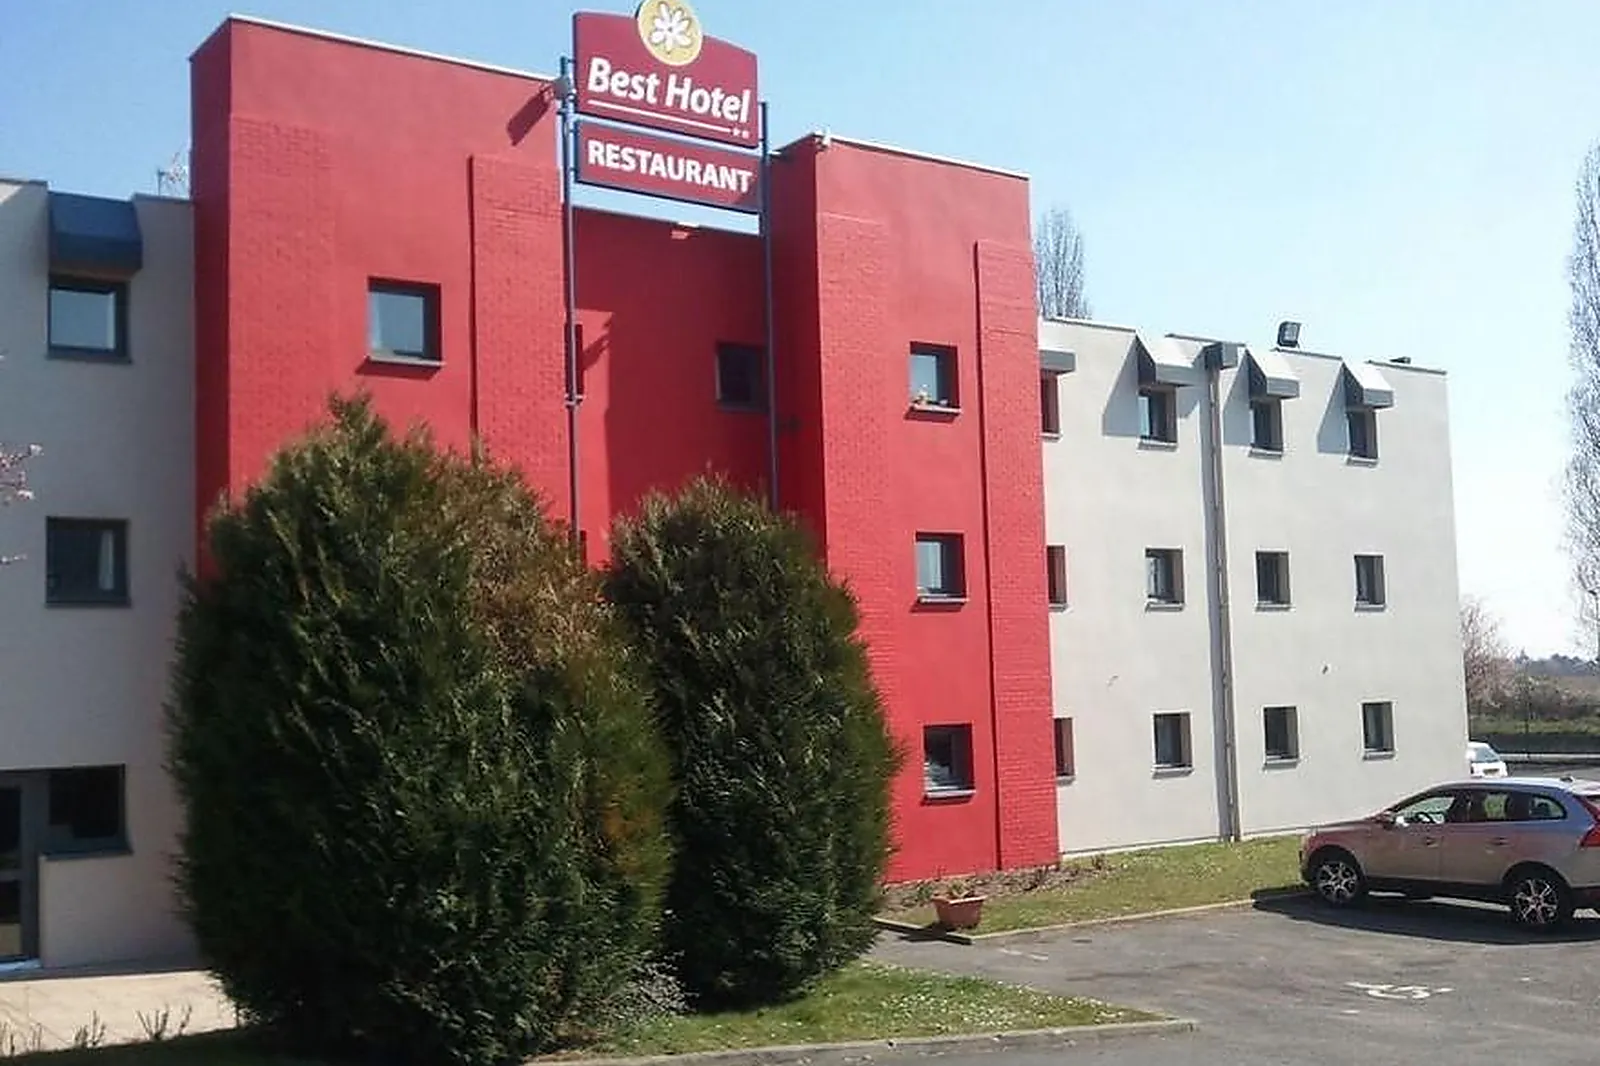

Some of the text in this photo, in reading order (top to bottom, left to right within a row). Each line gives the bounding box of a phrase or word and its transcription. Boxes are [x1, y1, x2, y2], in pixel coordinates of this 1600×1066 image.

[588, 57, 751, 123] Best Hotel
[588, 140, 753, 192] RESTAURANT
